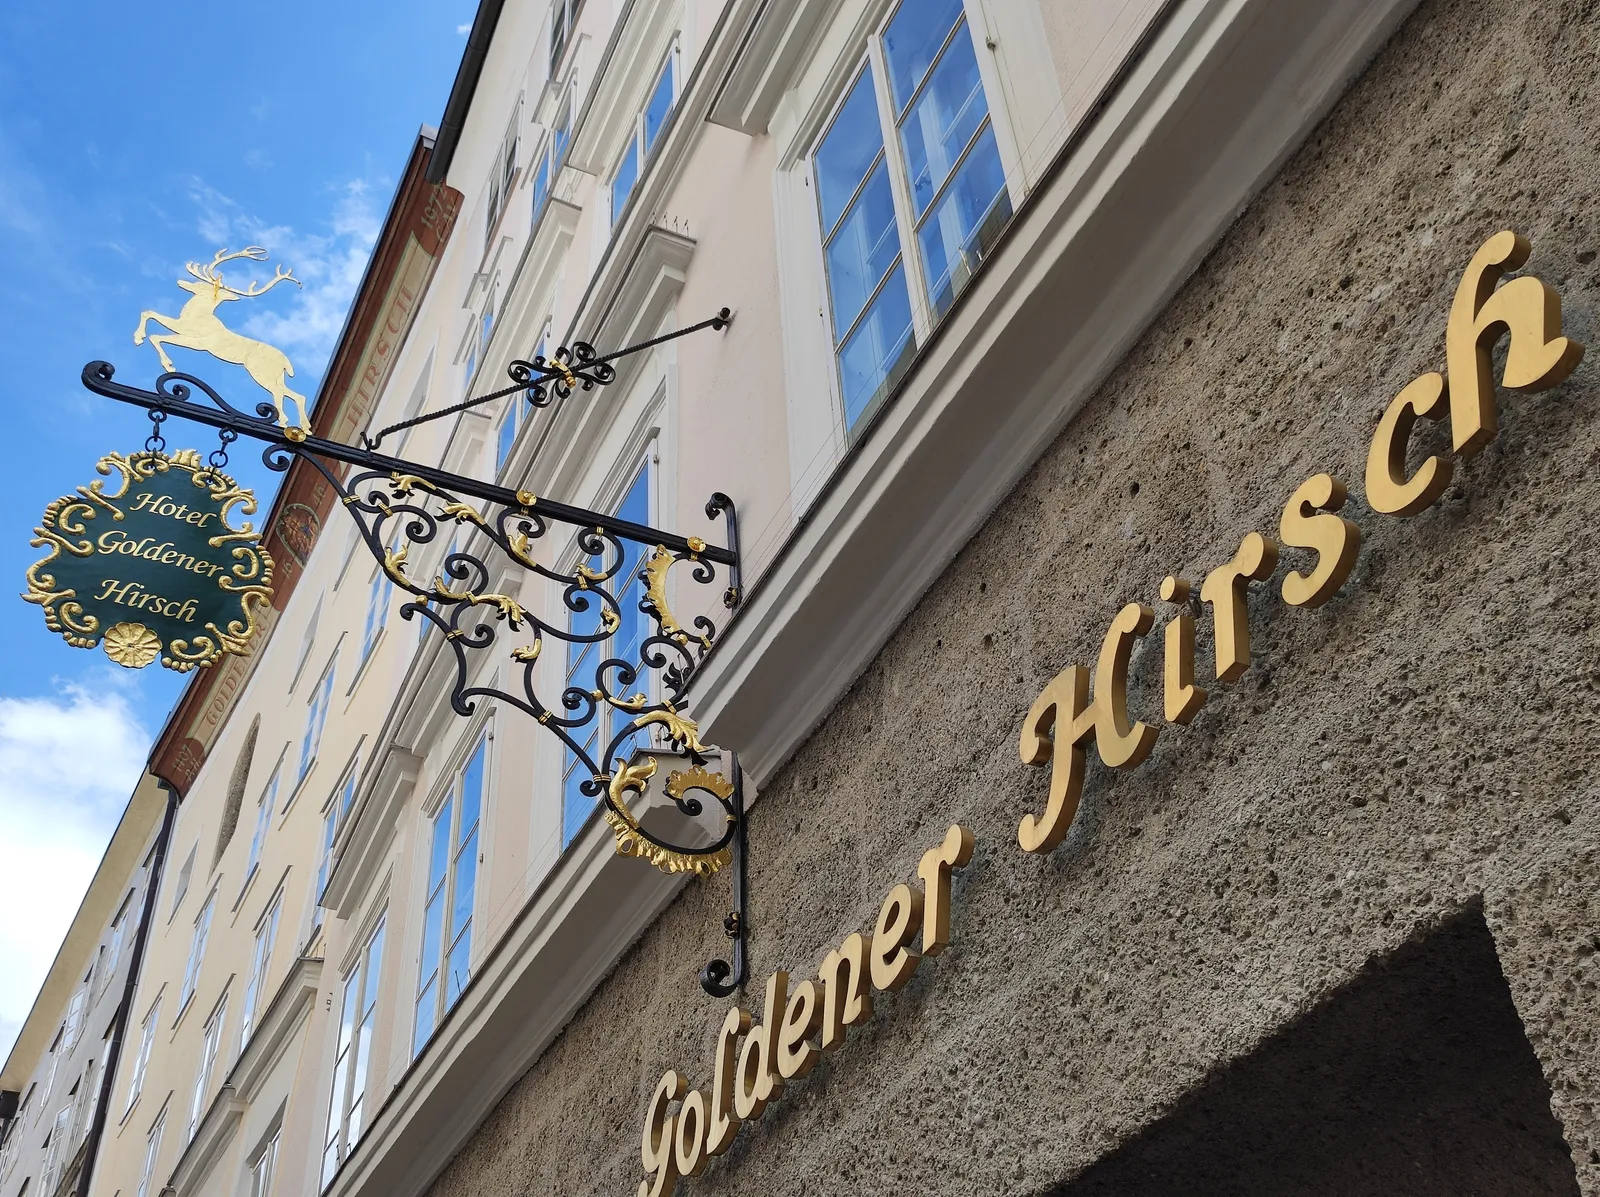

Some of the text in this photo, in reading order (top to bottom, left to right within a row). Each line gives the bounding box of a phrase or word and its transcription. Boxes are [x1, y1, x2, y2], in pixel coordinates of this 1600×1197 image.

[347, 286, 413, 427] HIRSCH
[129, 492, 217, 528] Hotel
[97, 530, 225, 578] Goldener
[94, 579, 200, 623] Hirsch
[637, 230, 1585, 1197] Goldener Hirsch
